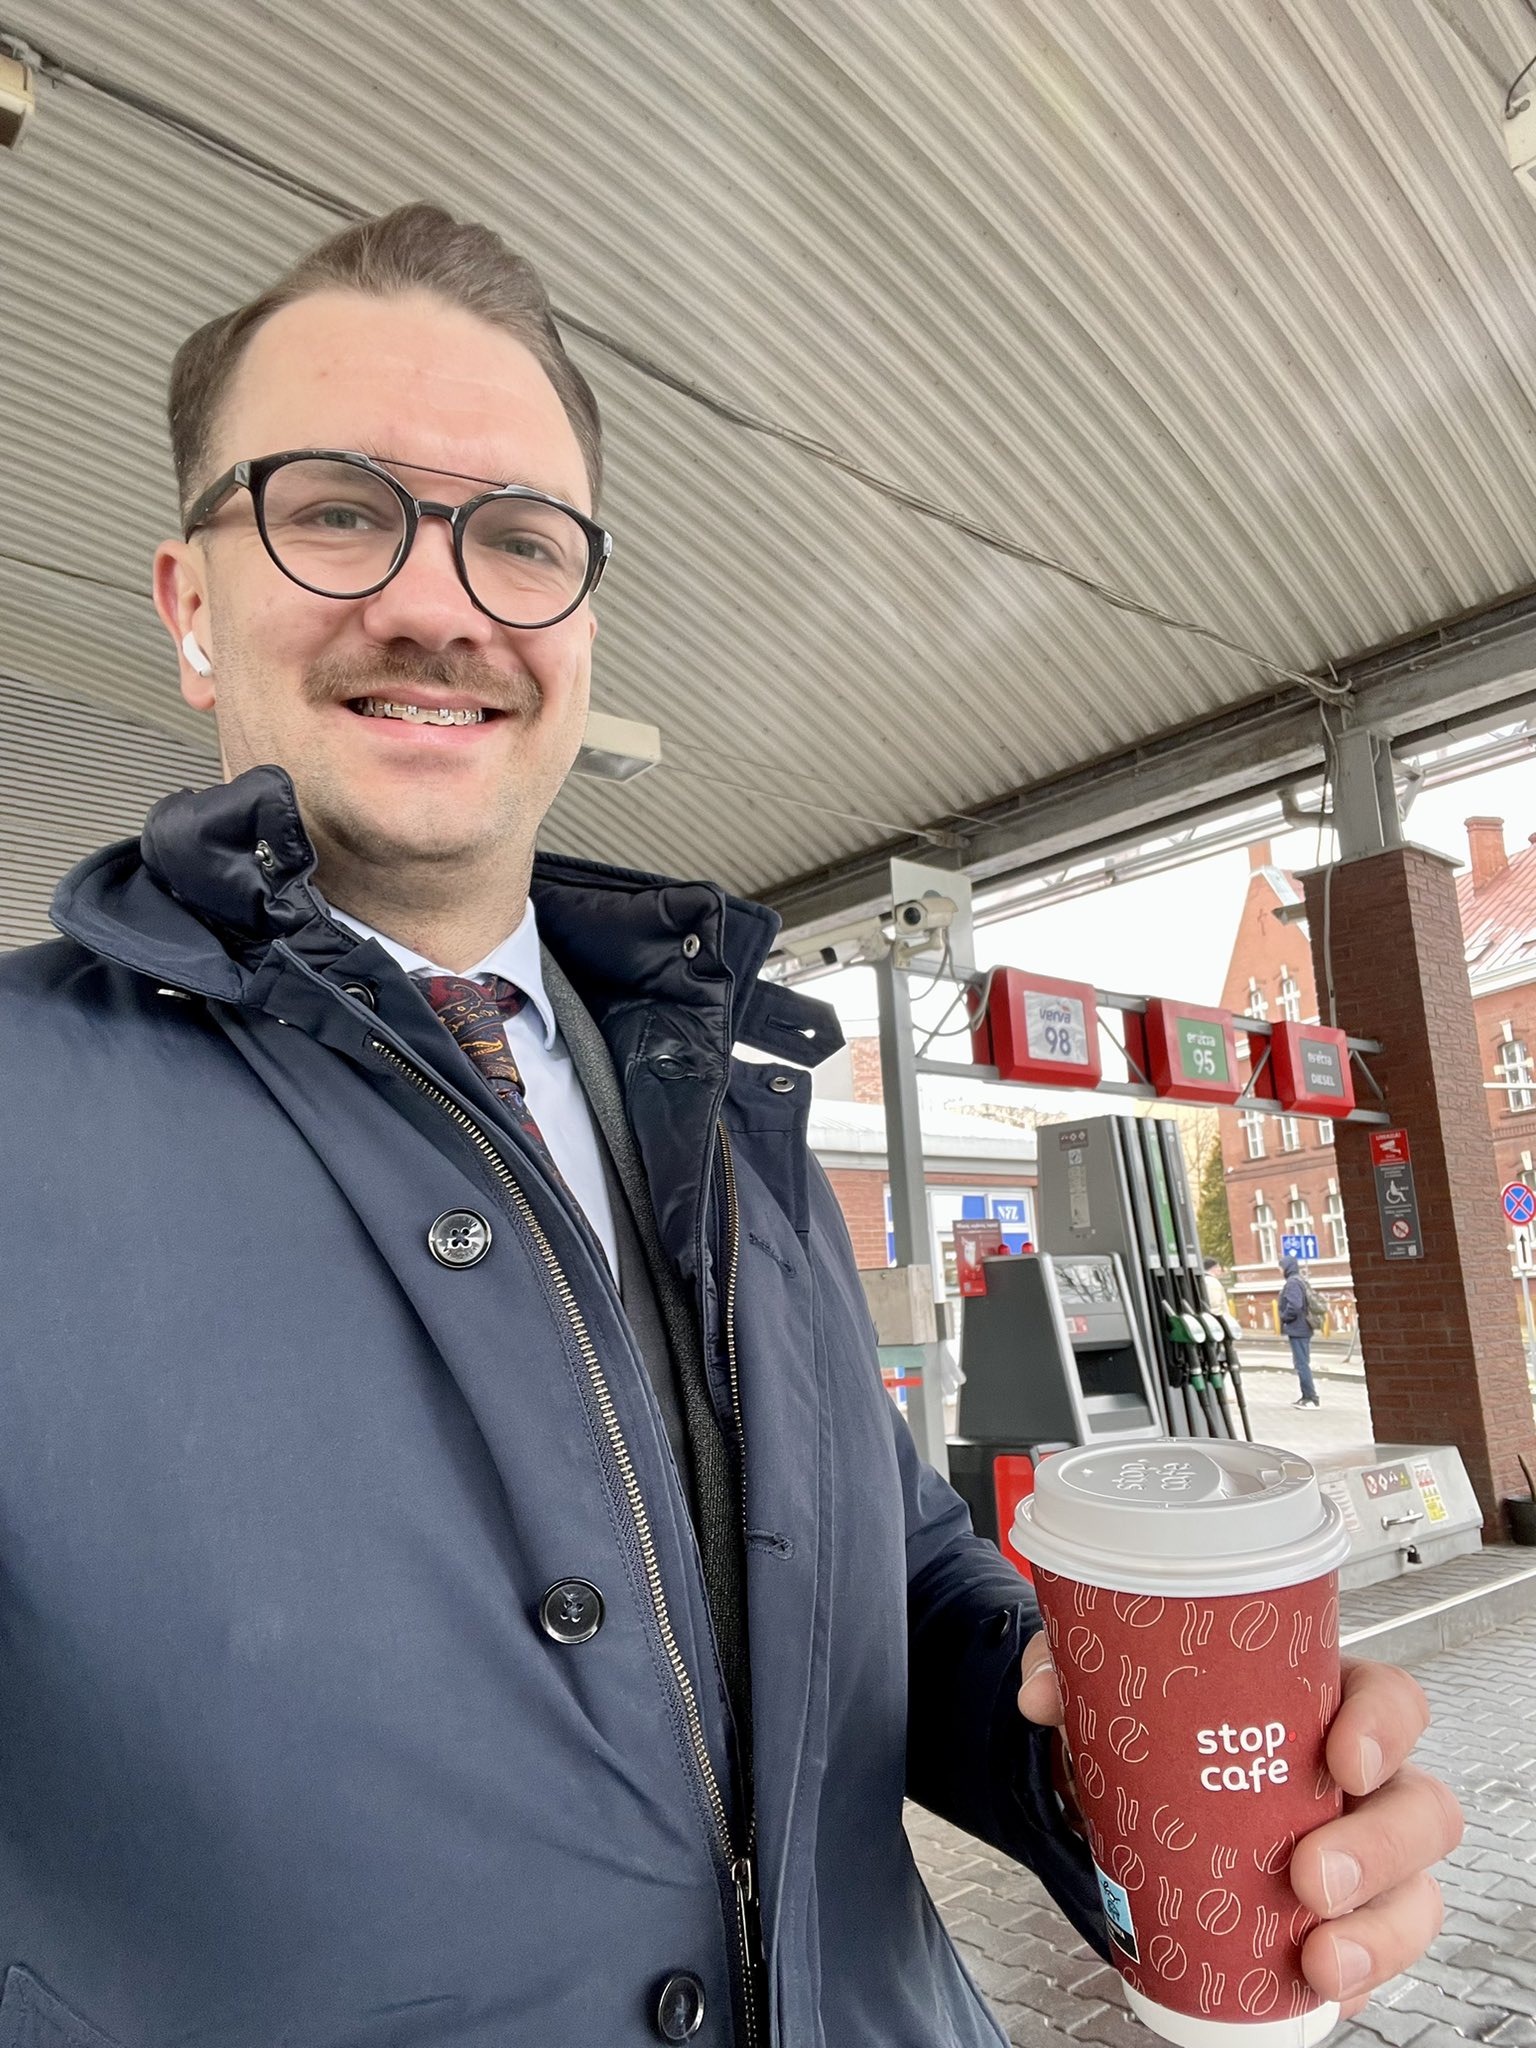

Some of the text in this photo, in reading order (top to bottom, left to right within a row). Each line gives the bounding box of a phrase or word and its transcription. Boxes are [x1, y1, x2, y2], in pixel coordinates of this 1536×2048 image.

[1040, 1008, 1071, 1023] verva
[1045, 1027, 1071, 1055] 98
[1193, 1049, 1215, 1075] 95
[1156, 1463, 1196, 1490] cafe
[1201, 1757, 1289, 1793] cafe
